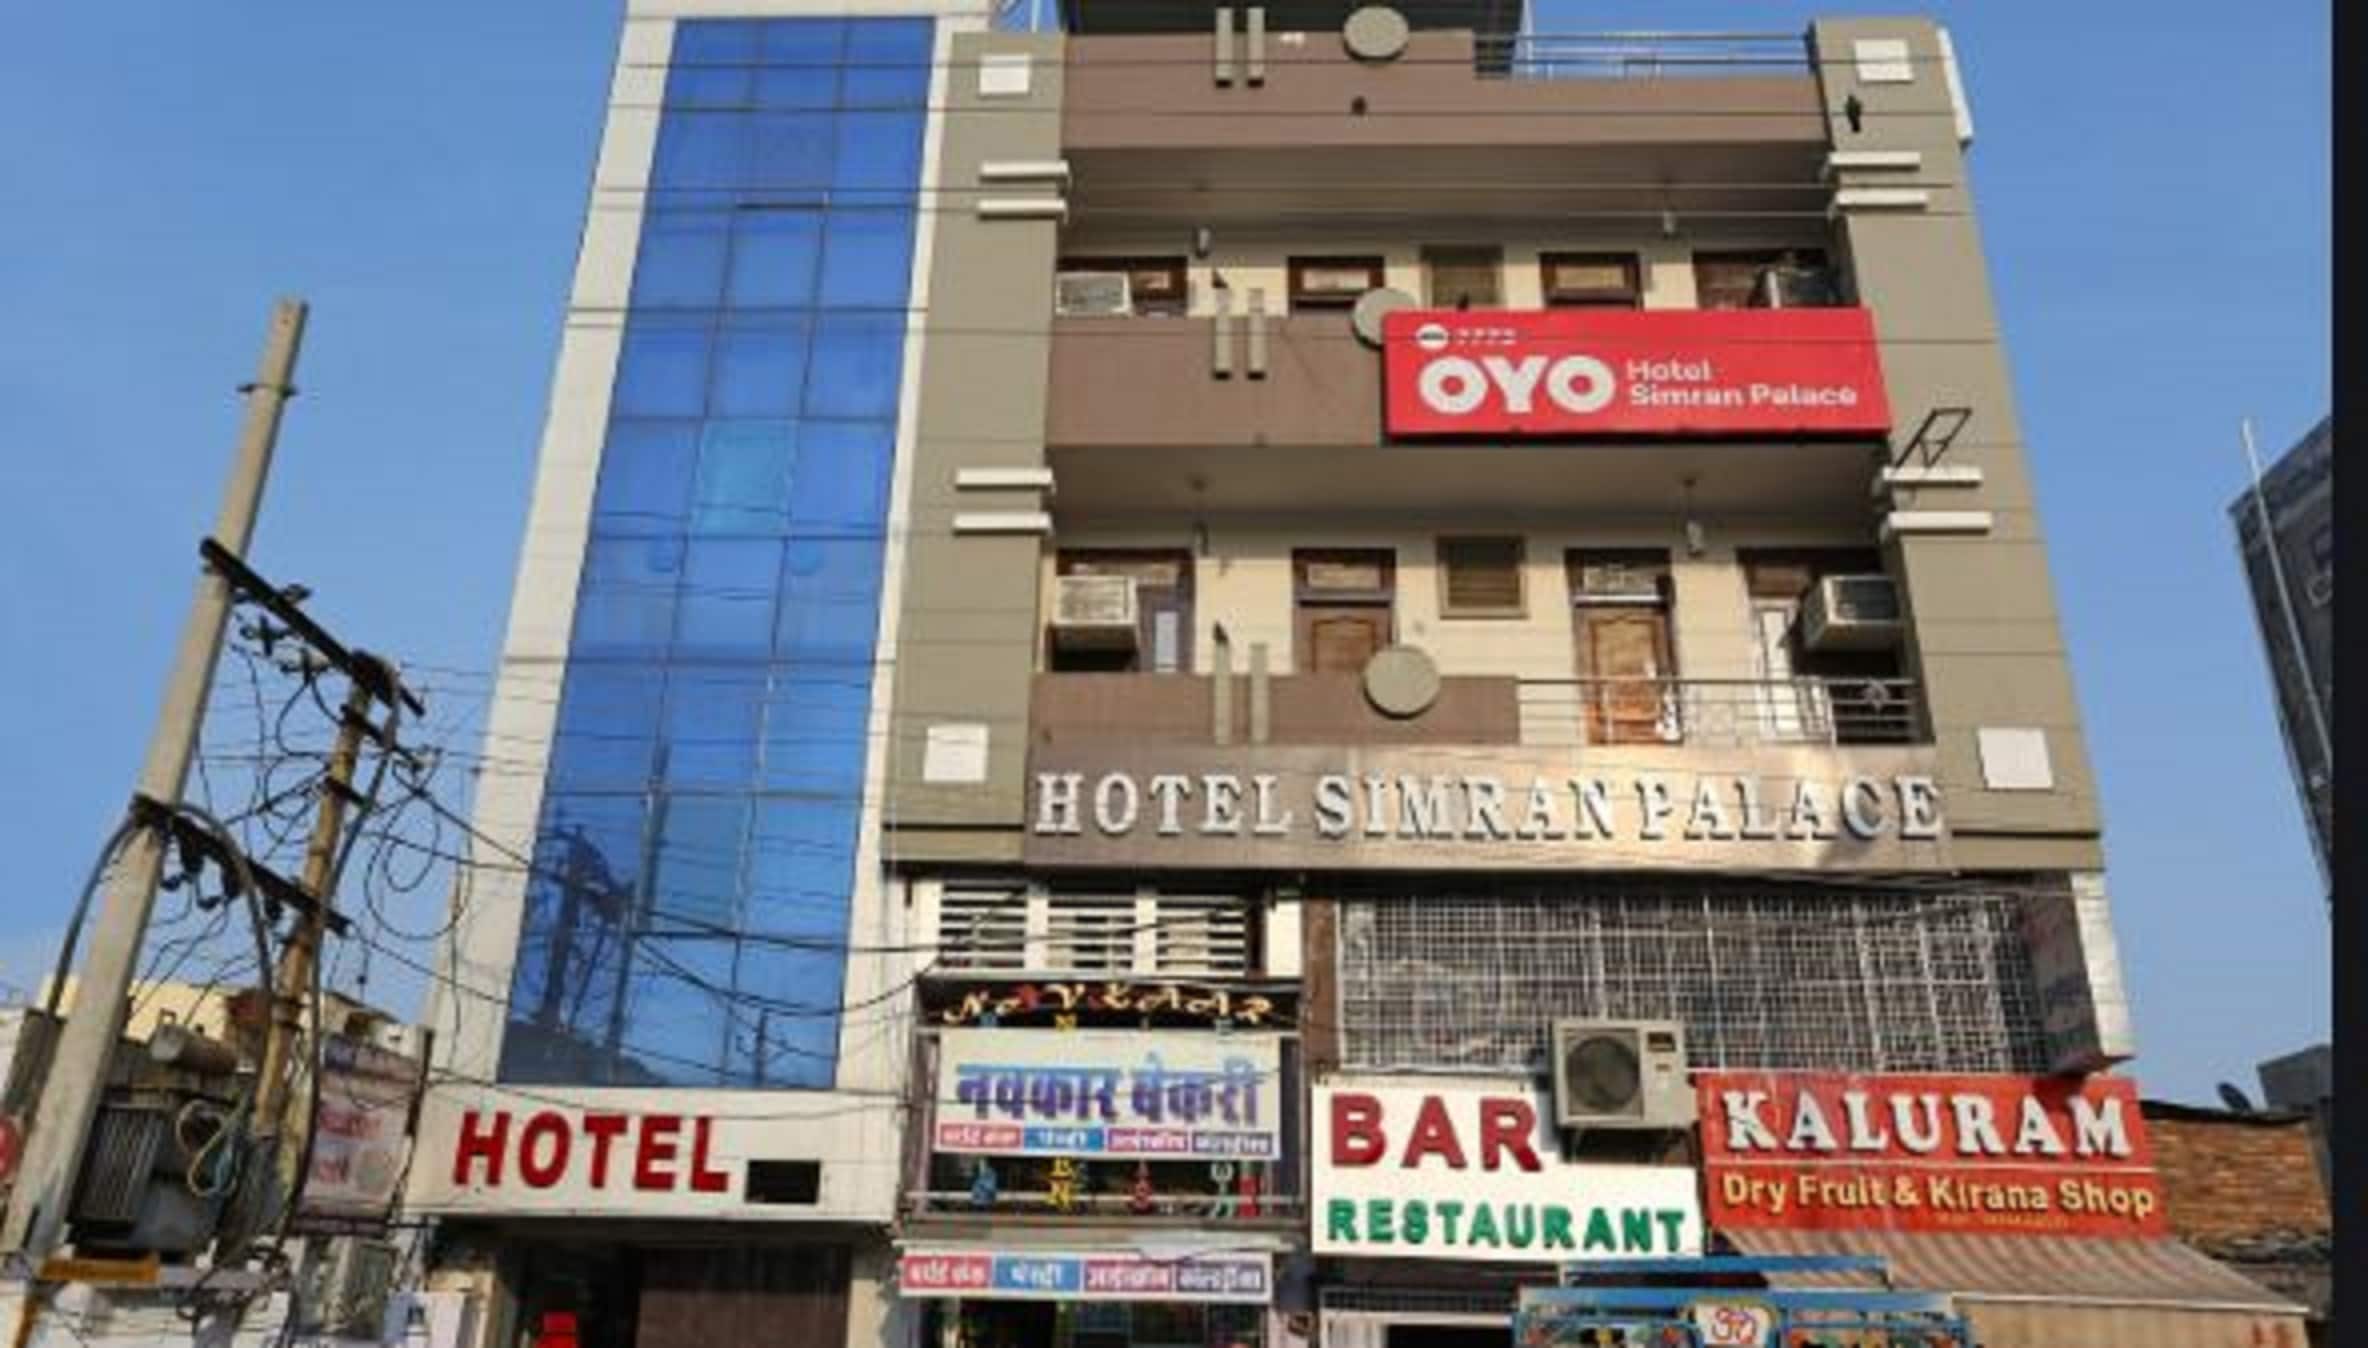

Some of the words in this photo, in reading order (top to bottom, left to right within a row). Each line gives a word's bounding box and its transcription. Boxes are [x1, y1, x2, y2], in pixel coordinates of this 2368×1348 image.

[1418, 355, 1615, 414] OYO
[1627, 359, 1711, 382] Hotel
[1629, 383, 1744, 407] Simran
[1751, 383, 1857, 407] Palace
[1034, 772, 1294, 838] HOTEL
[1313, 773, 1616, 842] SIMRAN
[1637, 775, 1943, 842] PALACE
[955, 1064, 1121, 1122] नवकार
[453, 1110, 730, 1194] HOTEL
[1331, 1092, 1543, 1173] BAR
[1722, 1089, 2133, 1158] KALURAM
[1722, 1171, 1788, 1212] Dry
[1798, 1175, 1890, 1208] Fruit
[1894, 1176, 1917, 1208] &
[1928, 1177, 2049, 1211] Kirana
[2059, 1179, 2155, 1219] Shop
[1328, 1199, 1686, 1252] RESTAURANT
